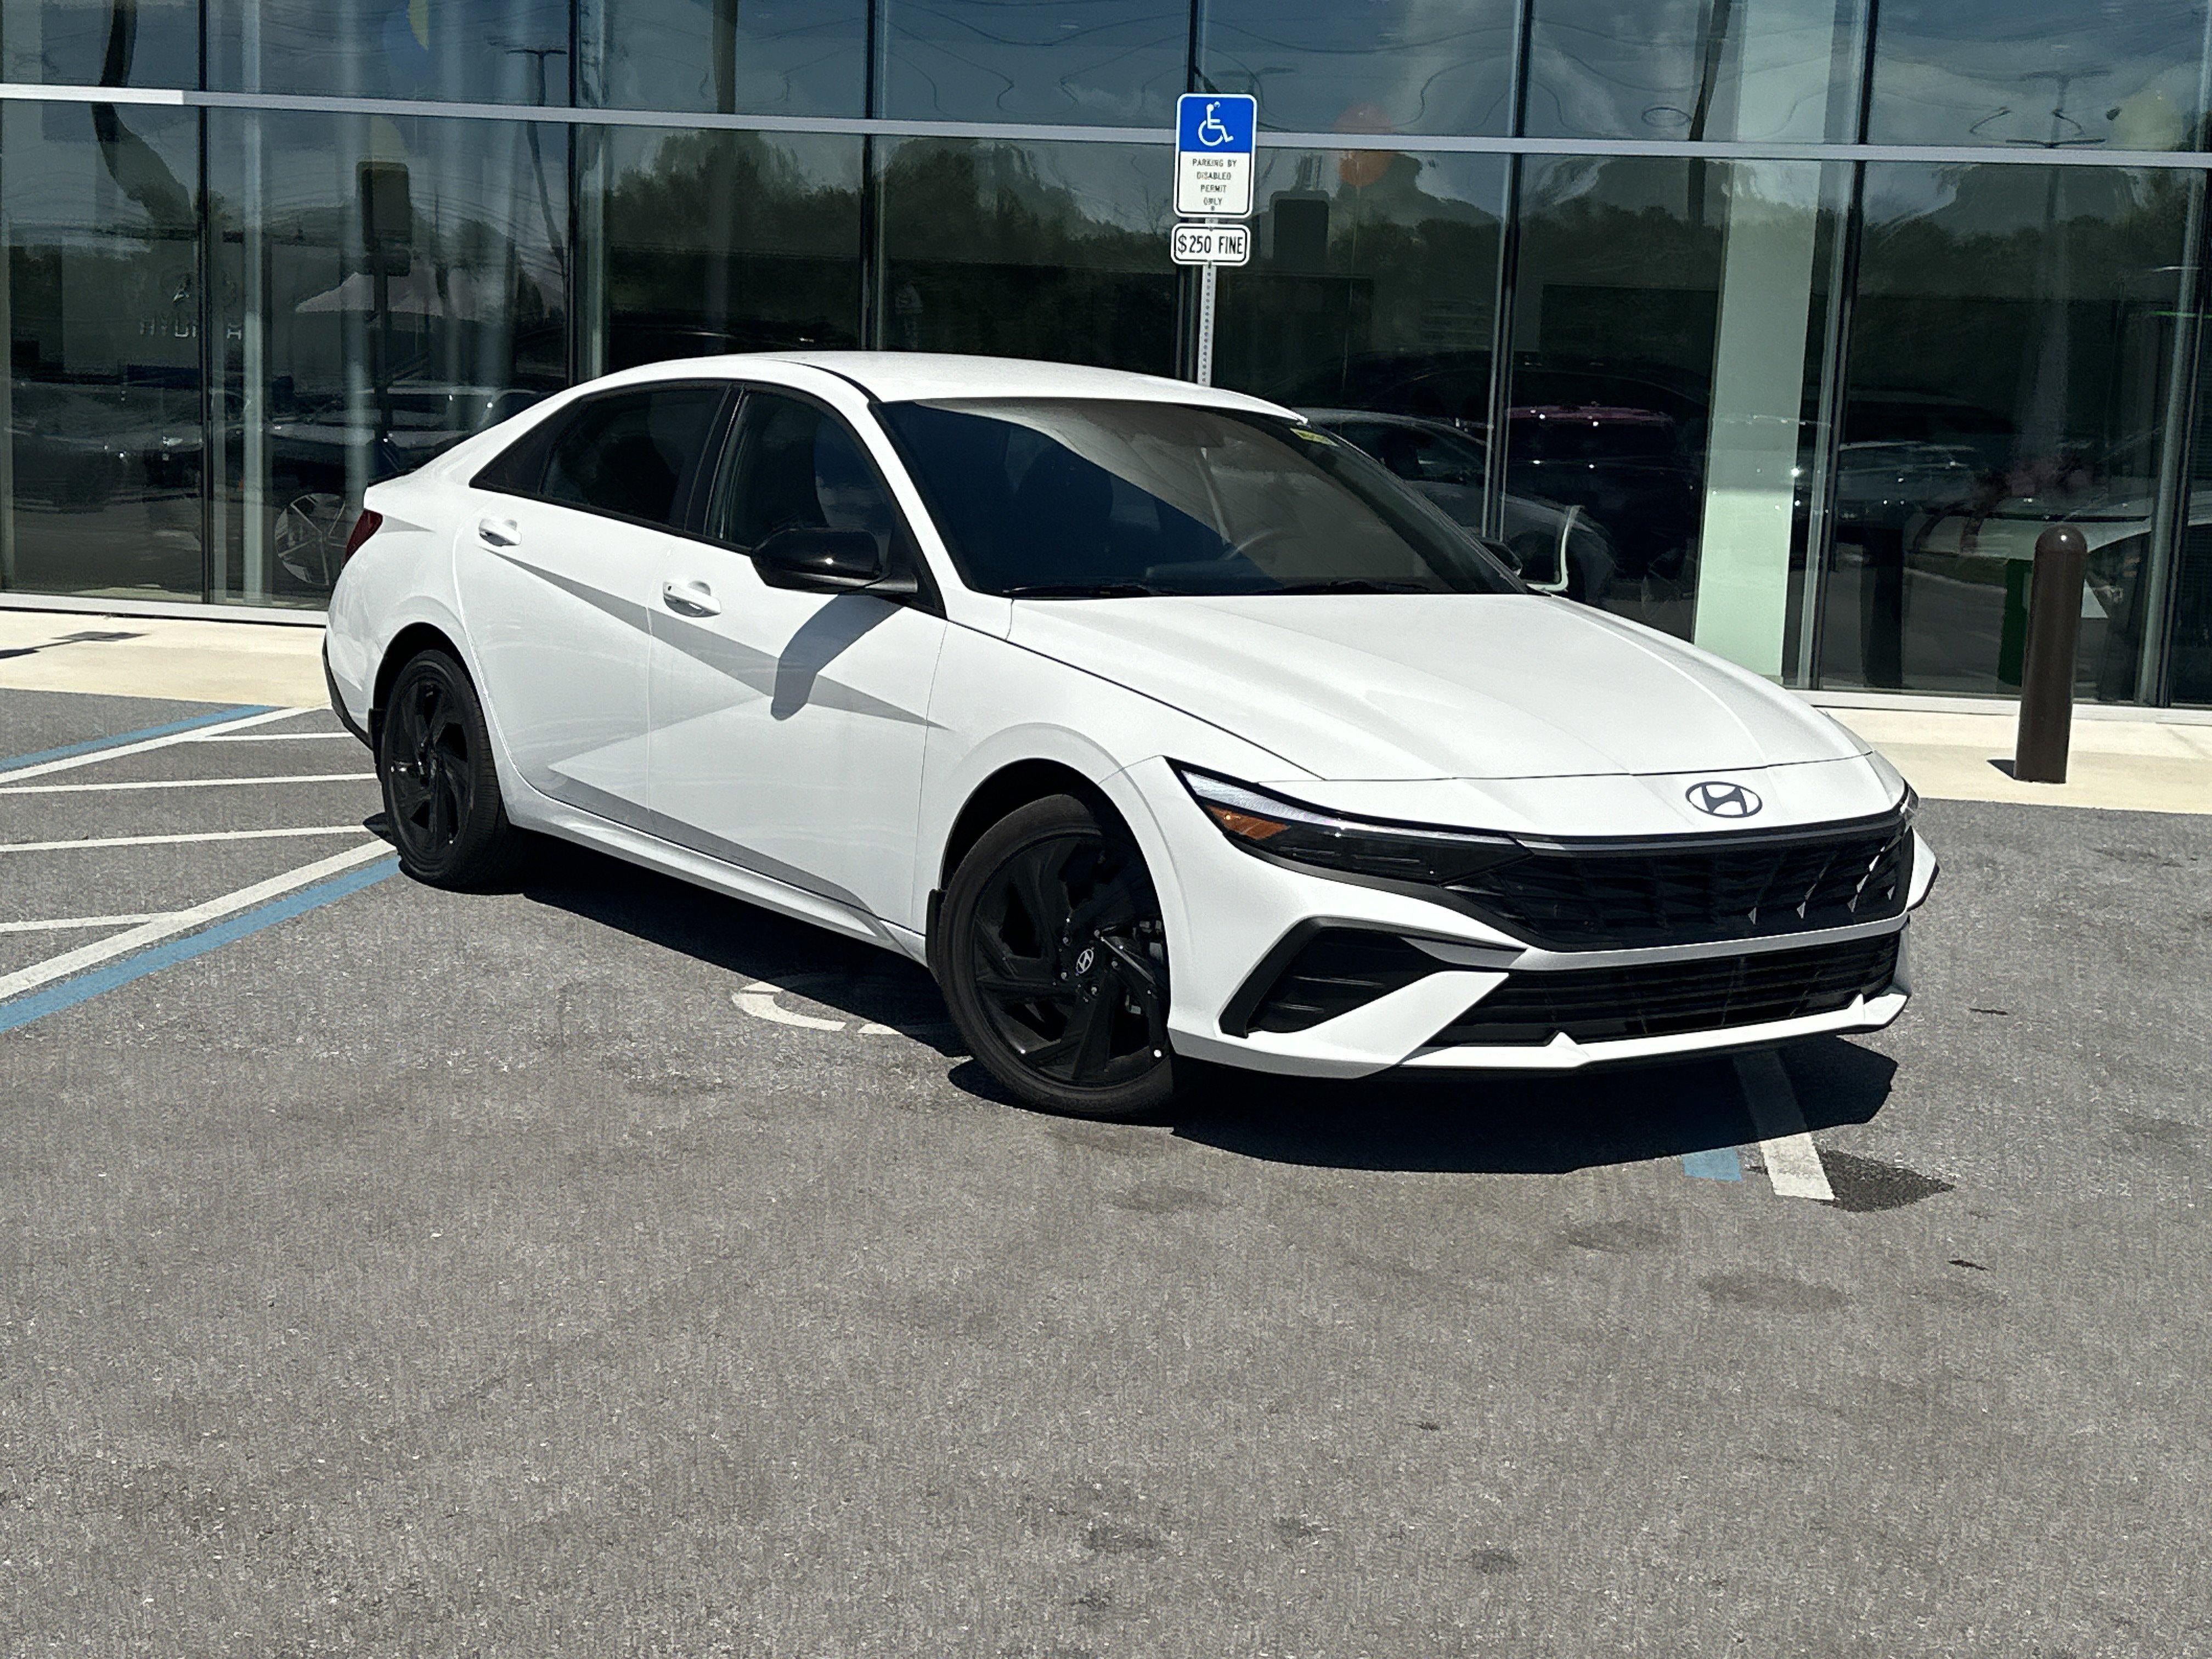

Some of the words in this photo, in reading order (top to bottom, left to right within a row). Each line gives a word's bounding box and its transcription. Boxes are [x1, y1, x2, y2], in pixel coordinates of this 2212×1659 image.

[1192, 158, 1223, 167] PARKING
[1227, 159, 1237, 167] BY
[1197, 171, 1232, 180] DISABLED
[1200, 184, 1227, 193] PERMIT
[1203, 197, 1223, 206] ONLY
[1177, 233, 1212, 255] $250
[1218, 235, 1244, 255] FINE
